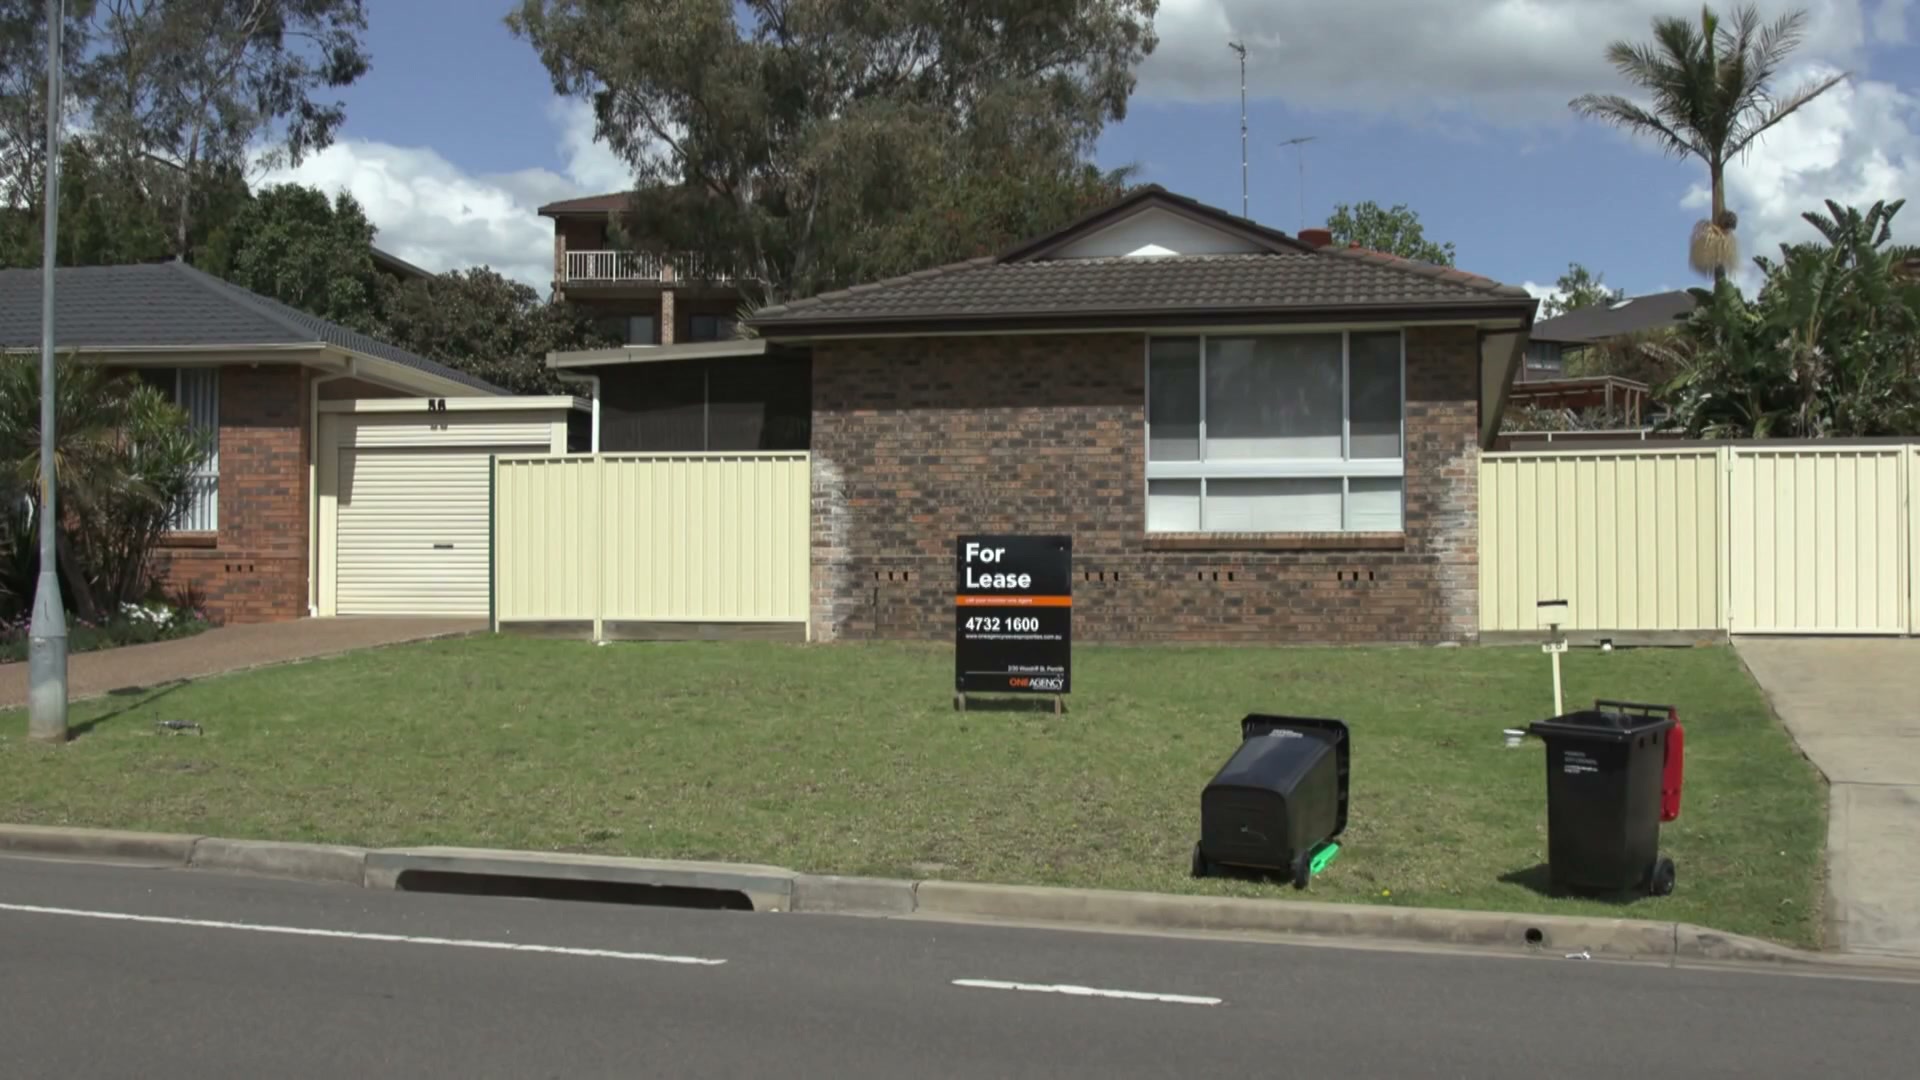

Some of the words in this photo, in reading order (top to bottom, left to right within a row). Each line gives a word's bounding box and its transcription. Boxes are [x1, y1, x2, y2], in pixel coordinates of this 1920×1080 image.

[966, 543, 1005, 563] For
[966, 567, 1031, 588] Lease
[965, 617, 1001, 632] 4732
[1005, 617, 1039, 632] 1600
